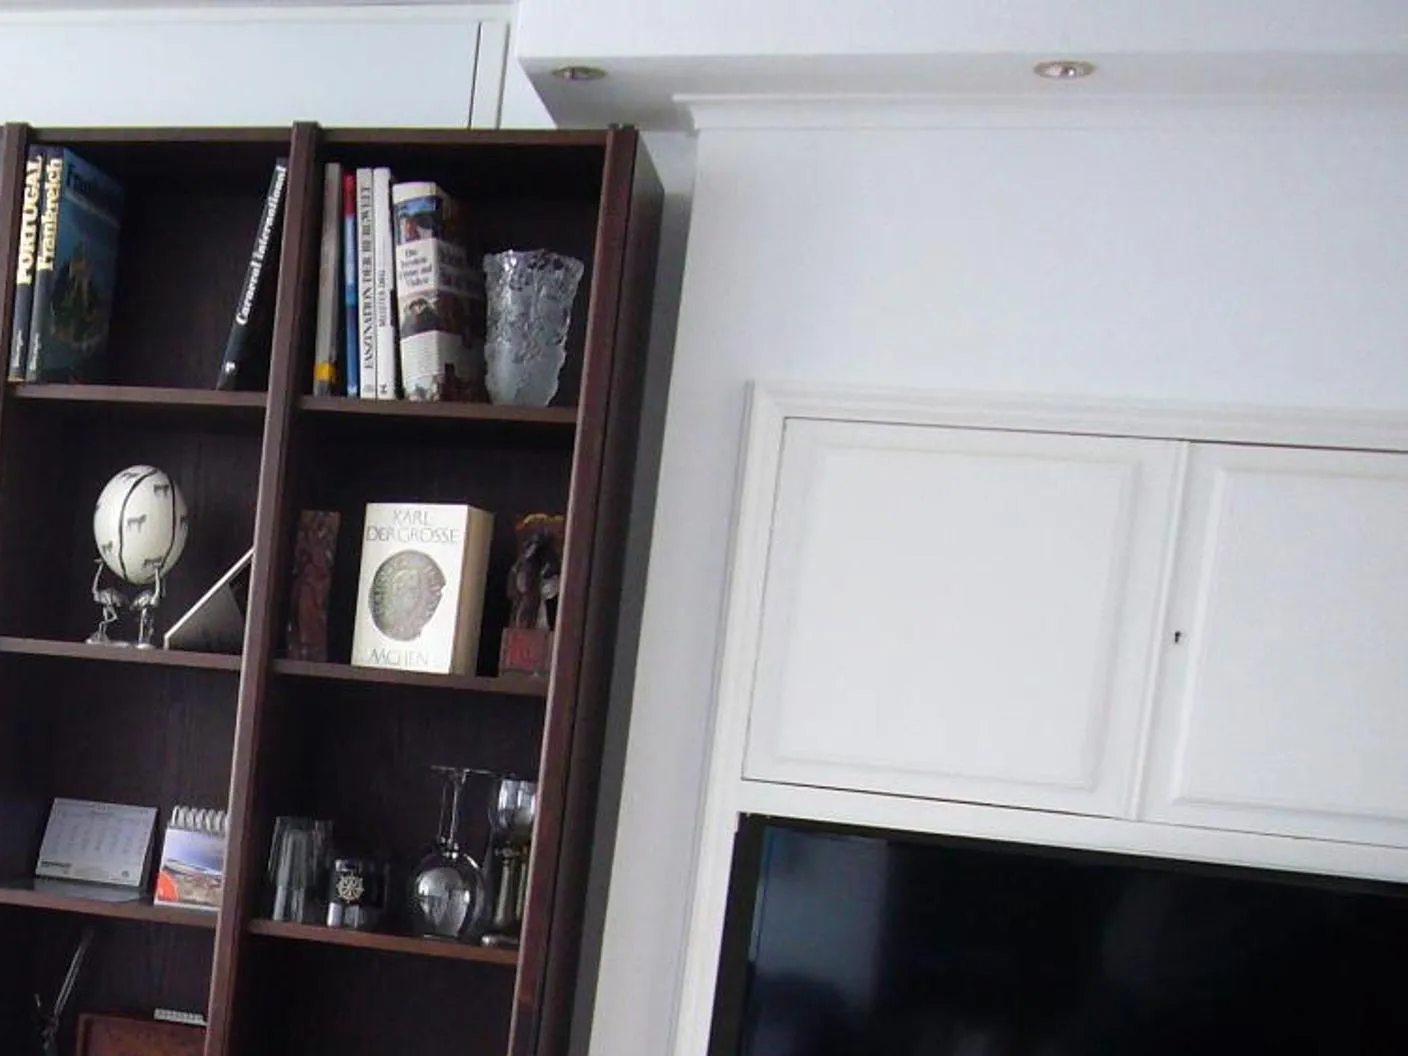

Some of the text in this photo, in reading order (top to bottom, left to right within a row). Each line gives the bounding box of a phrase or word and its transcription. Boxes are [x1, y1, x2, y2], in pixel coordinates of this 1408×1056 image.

[16, 155, 42, 285] PORTUGAL
[36, 158, 63, 271] Frankreich
[251, 165, 287, 261] International
[361, 256, 373, 283] DER
[362, 286, 375, 369] FASZINATION
[365, 525, 461, 543] DER GROSSE
[392, 509, 434, 527] KARL
[369, 648, 430, 667] AACHEN
